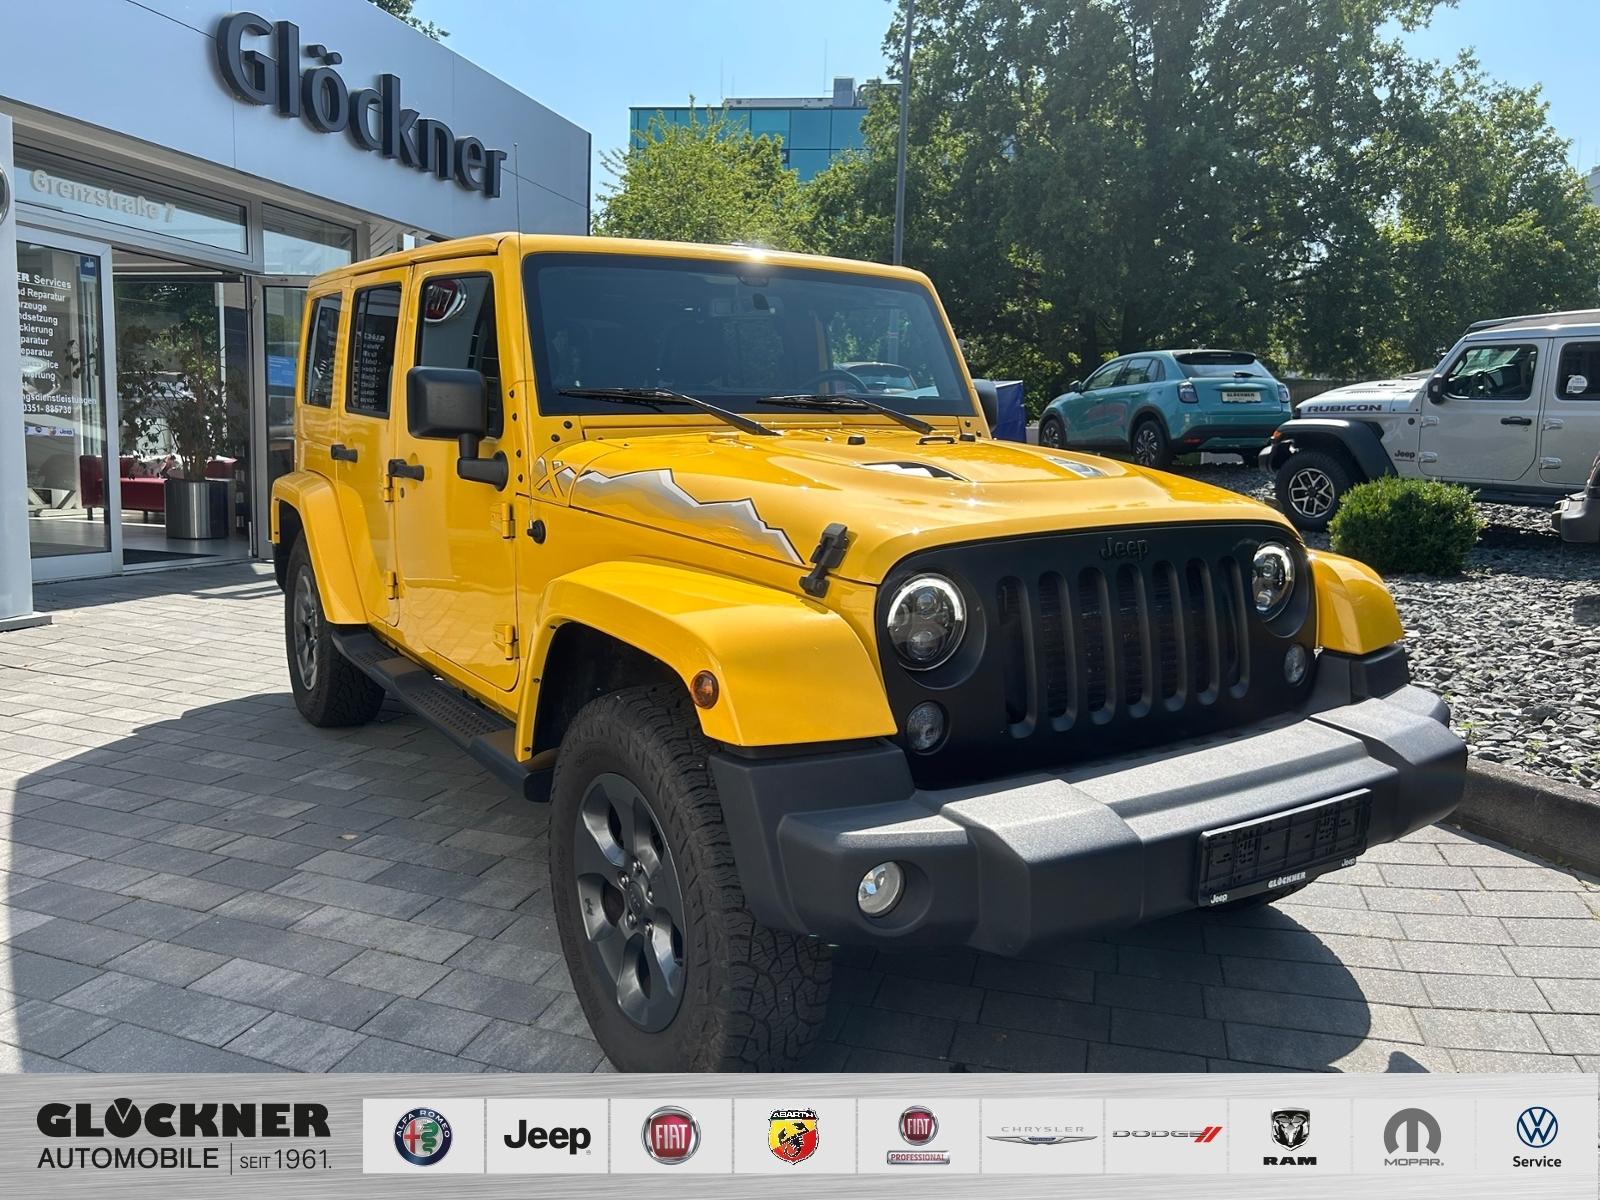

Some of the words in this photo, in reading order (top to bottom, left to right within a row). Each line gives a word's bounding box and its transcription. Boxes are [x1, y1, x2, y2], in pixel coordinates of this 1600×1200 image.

[216, 12, 507, 198] Glöckner
[31, 169, 160, 221] Grenzstraße
[164, 203, 176, 223] 7
[34, 275, 72, 289] Services
[27, 288, 66, 302] Reparatur
[1307, 404, 1383, 412] RUBICON
[1394, 450, 1416, 459] Jeep
[1100, 537, 1148, 561] Jeep
[1341, 857, 1356, 867] Jeep
[1210, 893, 1228, 903] Jeep
